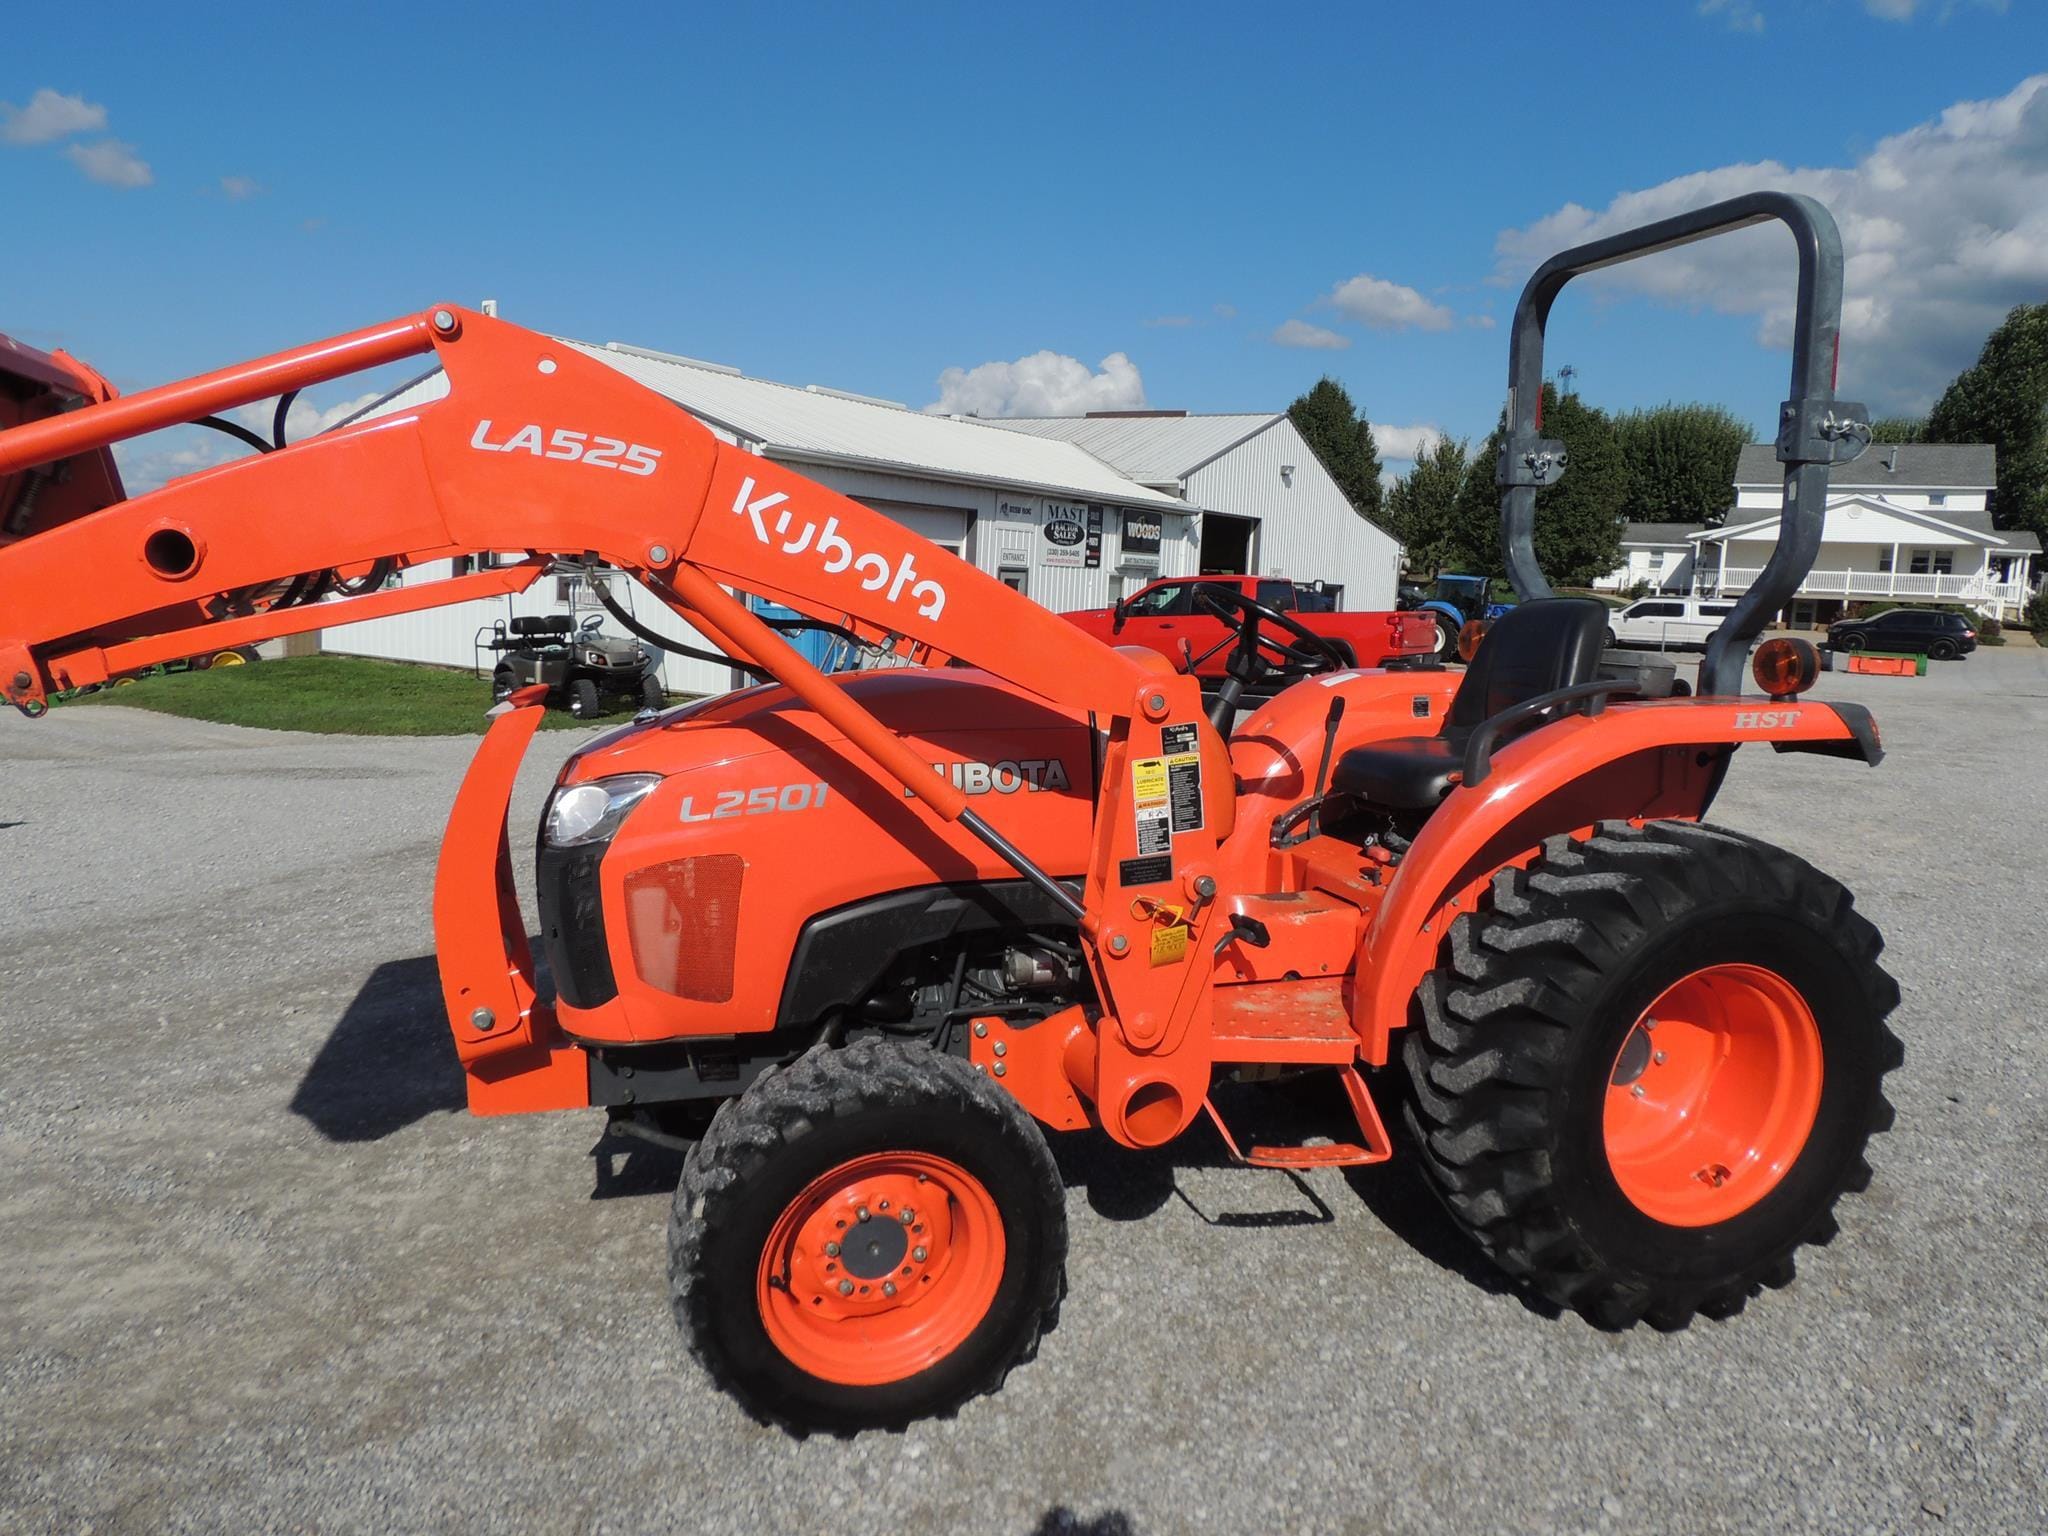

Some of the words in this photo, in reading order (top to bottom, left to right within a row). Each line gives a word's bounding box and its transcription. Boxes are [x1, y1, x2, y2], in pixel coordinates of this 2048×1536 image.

[470, 419, 664, 477] LA525
[1047, 504, 1085, 522] MAST
[1051, 521, 1079, 532] TRACTOR
[1053, 530, 1077, 540] SALES
[1127, 522, 1161, 540] WOODS
[731, 476, 947, 622] Kubota
[1002, 552, 1025, 562] ENTRANCE
[1733, 711, 1803, 729] HST
[679, 782, 829, 823] L2501
